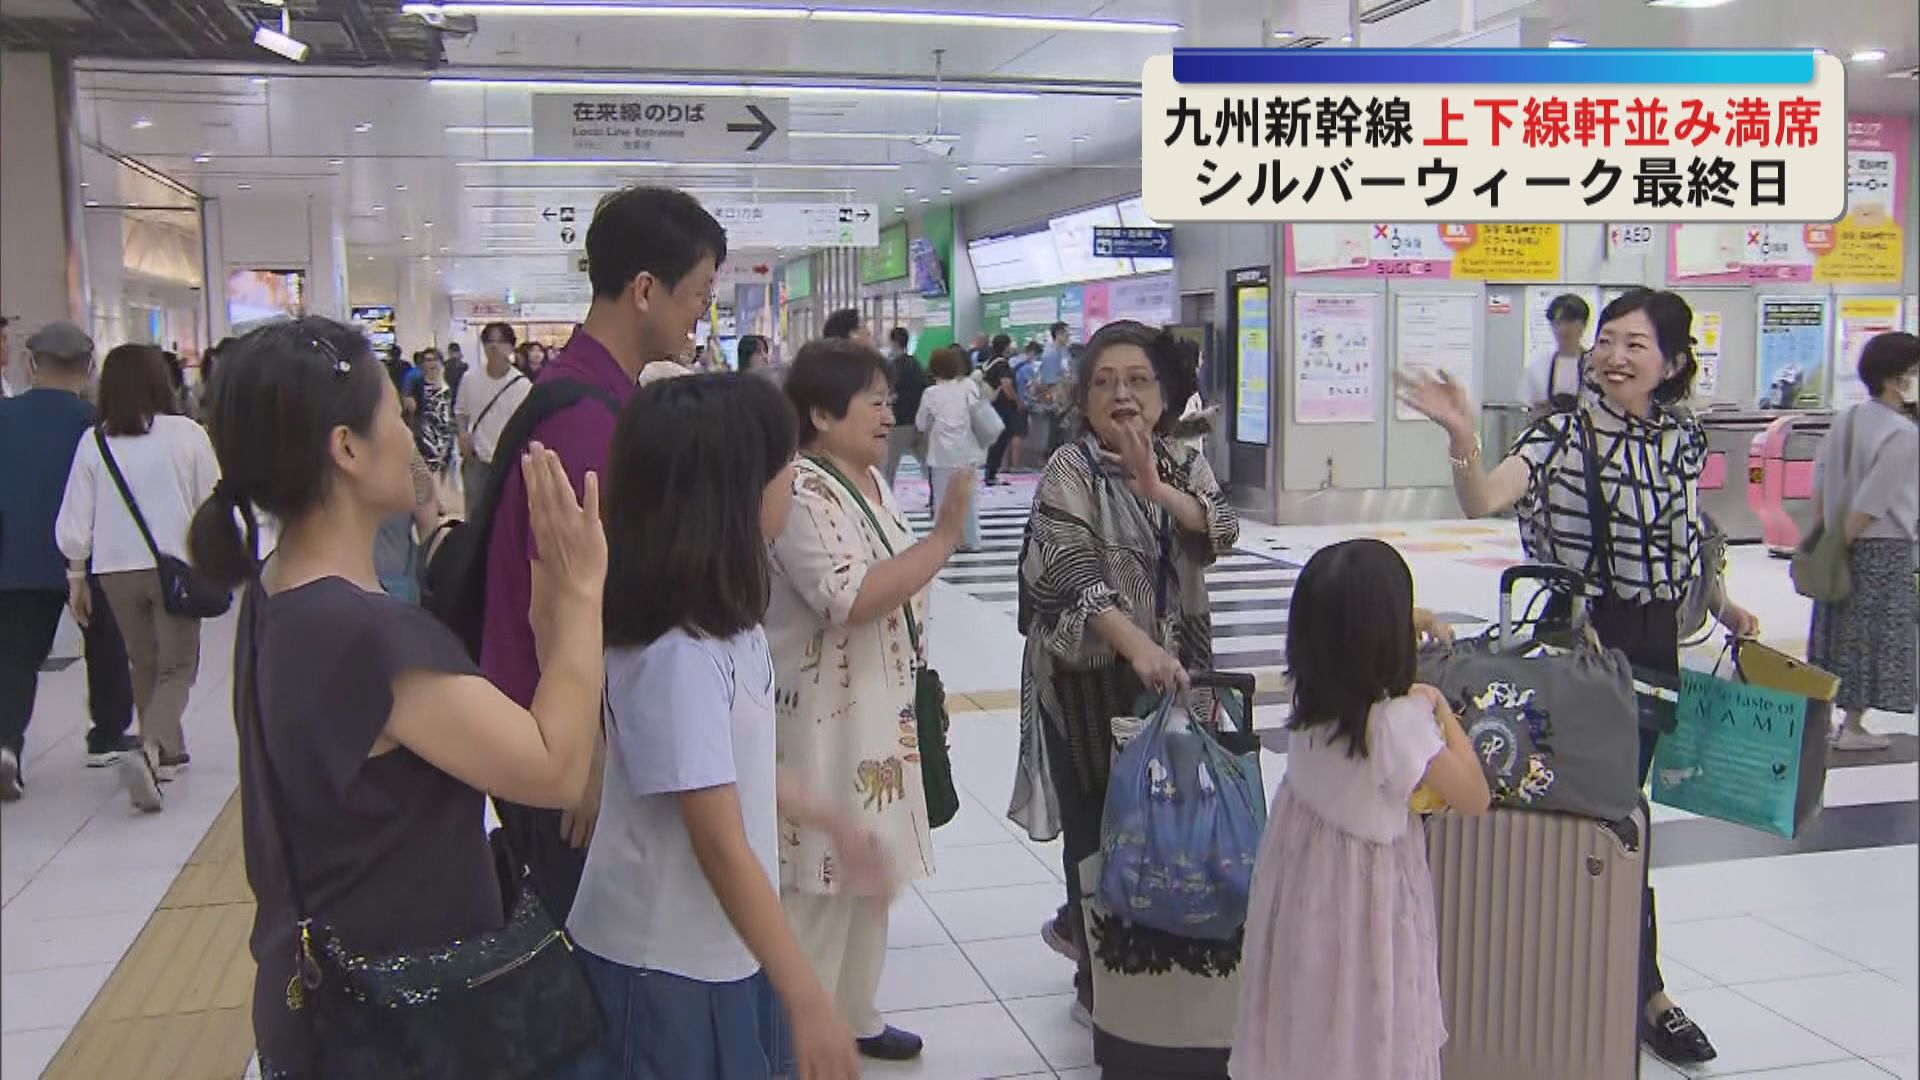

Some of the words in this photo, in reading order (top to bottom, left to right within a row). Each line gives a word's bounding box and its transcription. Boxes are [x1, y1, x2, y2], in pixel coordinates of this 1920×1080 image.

[572, 101, 705, 122] 在来線のりば
[1623, 227, 1652, 243] AED
